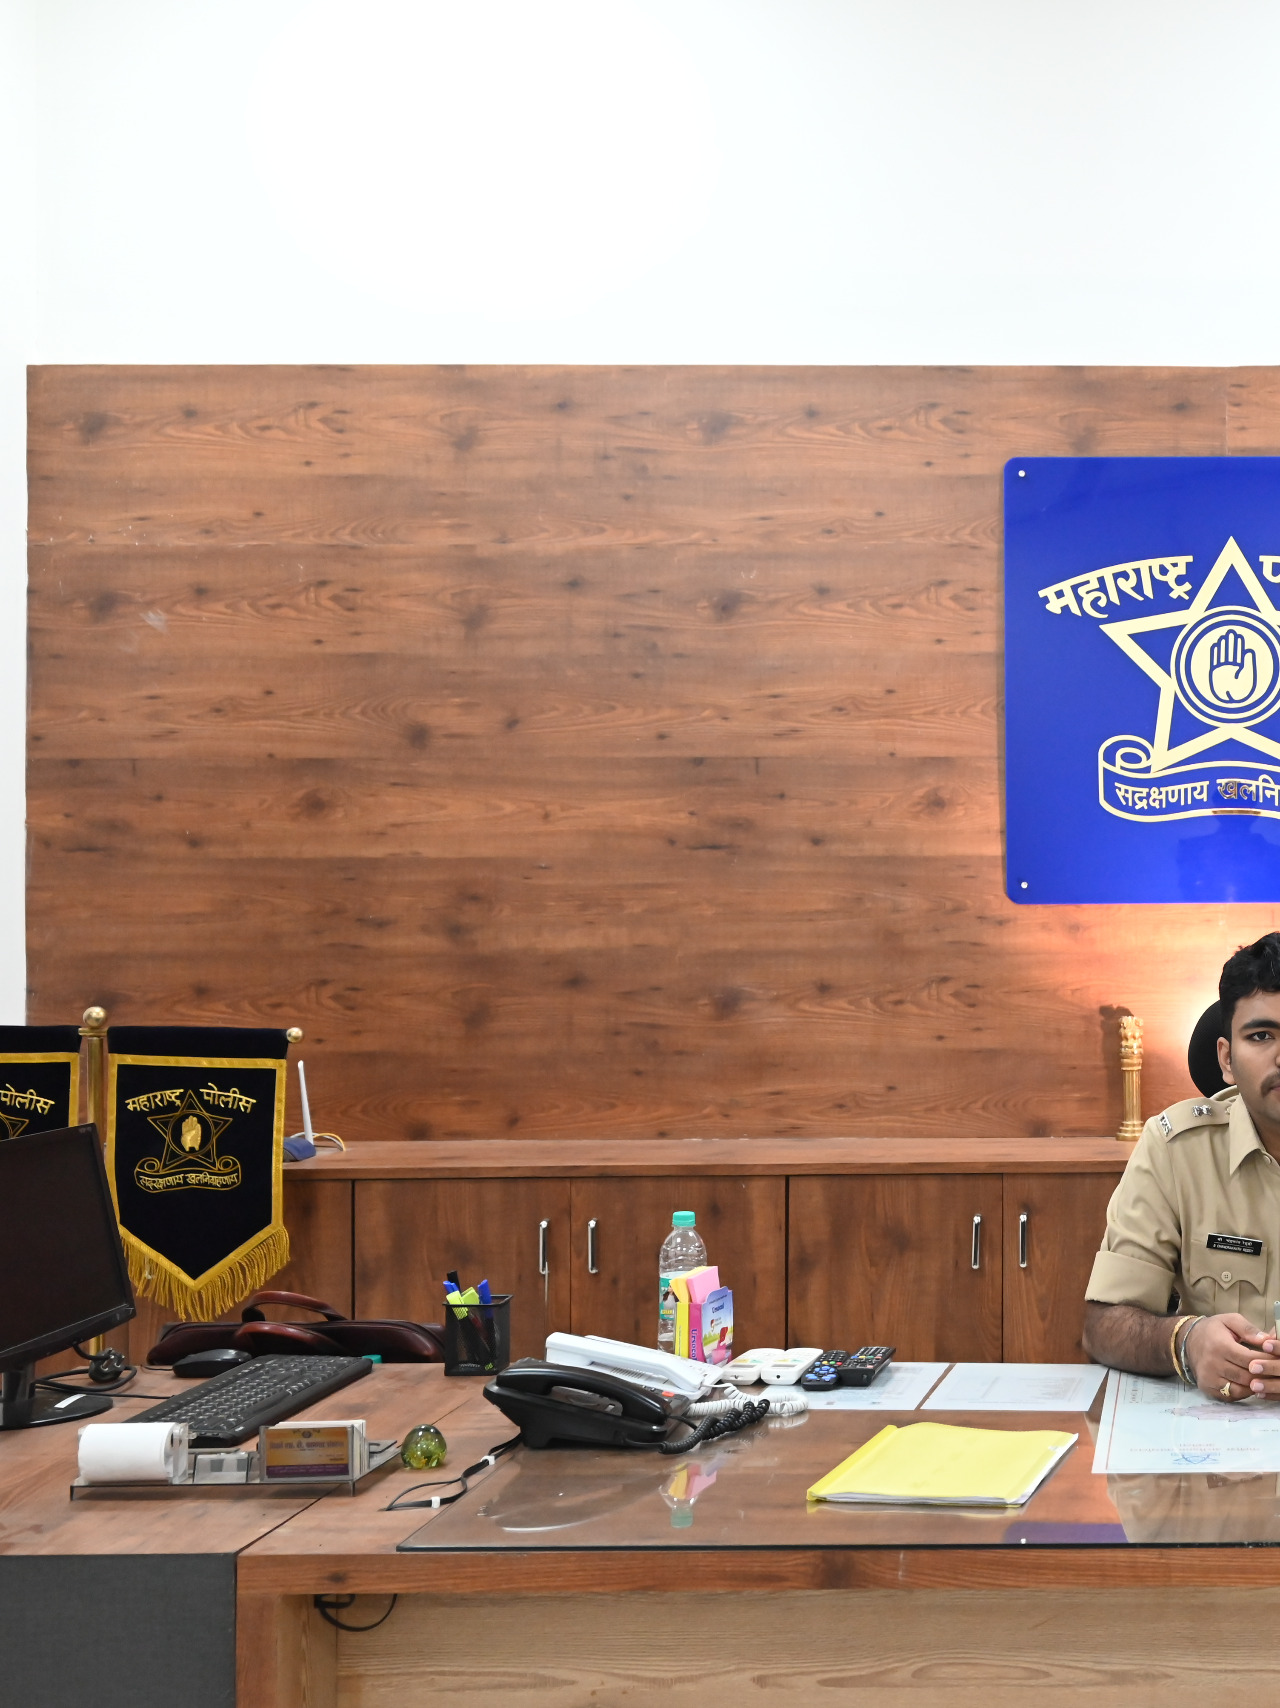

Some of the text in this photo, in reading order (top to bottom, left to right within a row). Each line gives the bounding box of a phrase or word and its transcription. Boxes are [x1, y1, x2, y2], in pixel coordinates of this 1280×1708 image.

[1038, 555, 1193, 618] महाराष्ट्र
[1114, 780, 1209, 810] सद्रक्षणाय
[0, 1083, 55, 1115] पोलीस
[125, 1082, 257, 1114] महाराष्ट्र पोलीस
